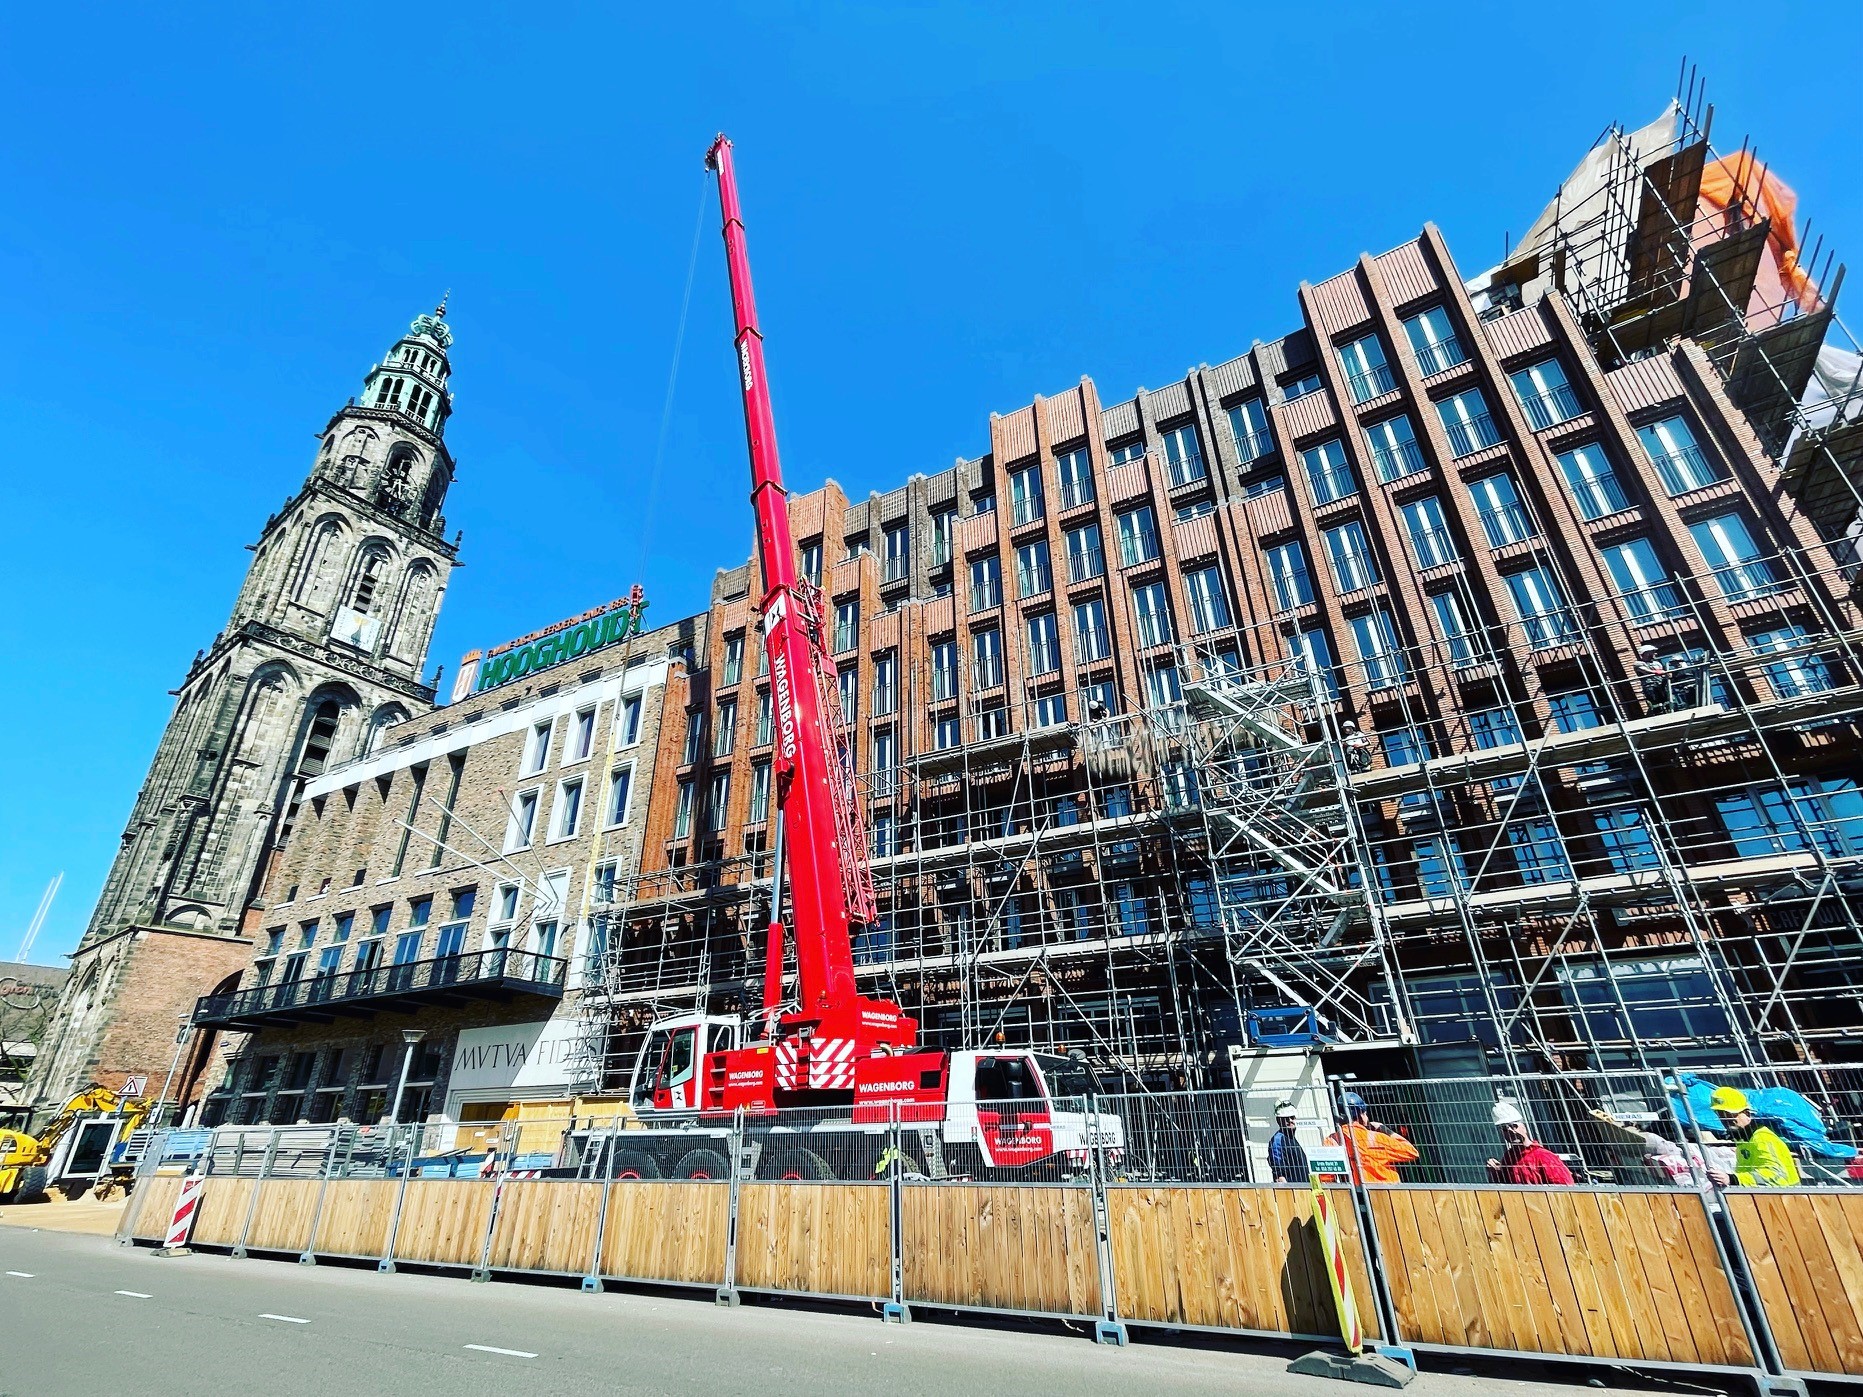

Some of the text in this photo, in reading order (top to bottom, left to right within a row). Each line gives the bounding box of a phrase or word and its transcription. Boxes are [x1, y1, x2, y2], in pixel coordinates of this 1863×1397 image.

[478, 600, 650, 692] HOOGHOUDT
[774, 652, 797, 759] WAGENBORG
[861, 1010, 898, 1022] WAGENBORG
[455, 1042, 526, 1071] MVTVA
[728, 1070, 764, 1080] WAGENBORG
[858, 1080, 915, 1093] WAGENBORG
[994, 1136, 1042, 1145] WAGENBORG
